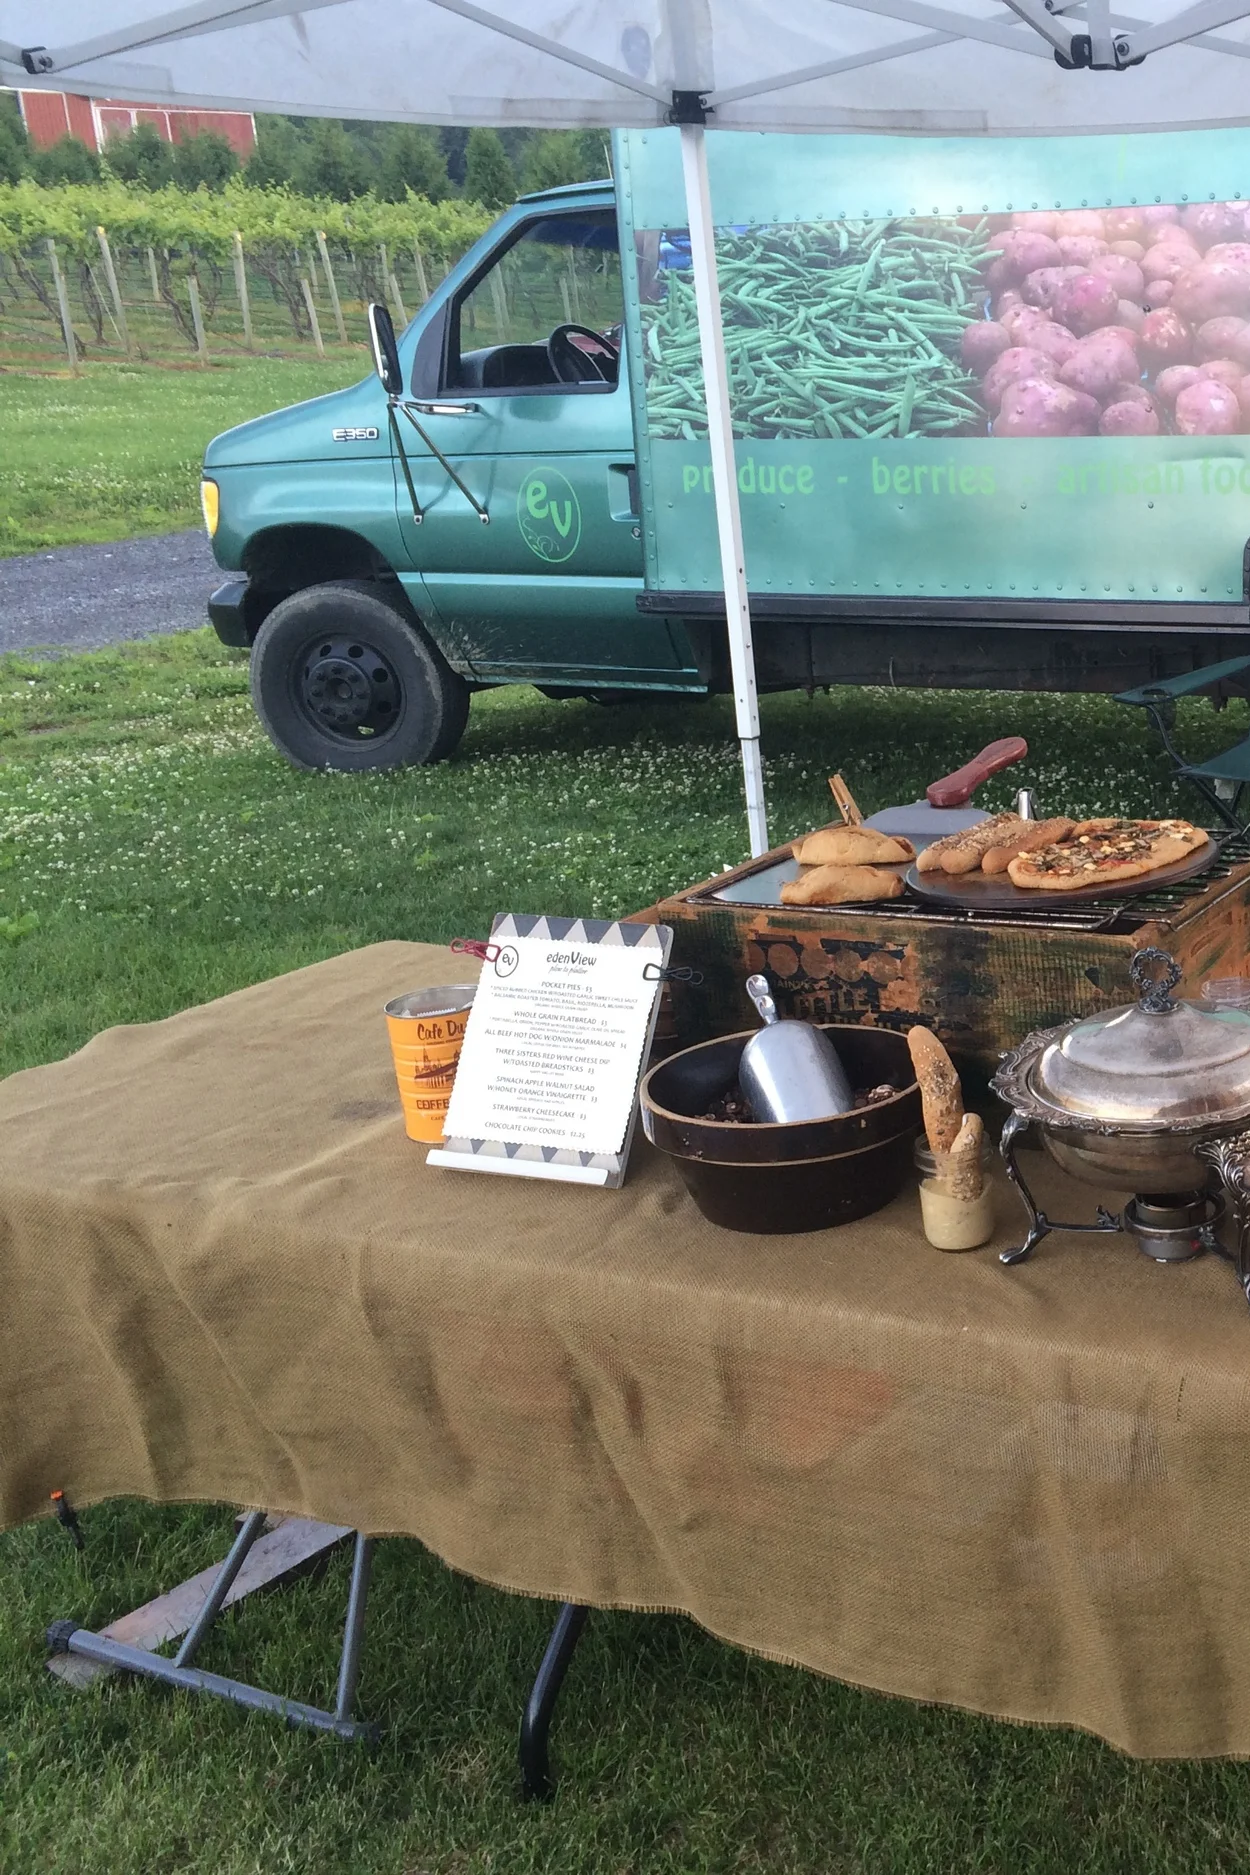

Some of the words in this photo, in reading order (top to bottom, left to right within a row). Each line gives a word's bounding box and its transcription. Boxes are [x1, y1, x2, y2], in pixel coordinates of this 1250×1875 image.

[332, 427, 379, 442] E350
[682, 457, 814, 494] prduce
[871, 456, 996, 495] berries
[1057, 455, 1185, 495] artisan
[546, 951, 597, 966] edenView
[541, 981, 566, 989] POCKET
[567, 983, 581, 991] PIES
[538, 1013, 559, 1021] GRAIN
[559, 1015, 597, 1025] FLATBREAD
[446, 1020, 464, 1037] Du
[485, 1028, 496, 1036] ALL
[497, 1029, 513, 1037] BEEF
[529, 1032, 543, 1040] DOG
[575, 1038, 616, 1048] MARMALADE
[496, 1048, 515, 1056] THREE
[516, 1050, 541, 1058] SISTERS
[556, 1054, 573, 1062] WINE
[574, 1056, 598, 1065] CHEESE
[541, 1062, 584, 1072] BREADSTICKS
[496, 1075, 524, 1084] SPINACH
[524, 1079, 544, 1087] APPLE
[545, 1081, 573, 1090] WALNUT
[574, 1084, 595, 1092] SALAD
[518, 1088, 544, 1097] ORANGE
[546, 1091, 587, 1101] VINAIGRETTE
[416, 1098, 449, 1110] COFFE
[492, 1103, 535, 1114] STRAWBERRY
[536, 1108, 576, 1118] CHEESECAKE
[484, 1121, 522, 1131] CHOCOLATE
[538, 1127, 566, 1136] COOKIES
